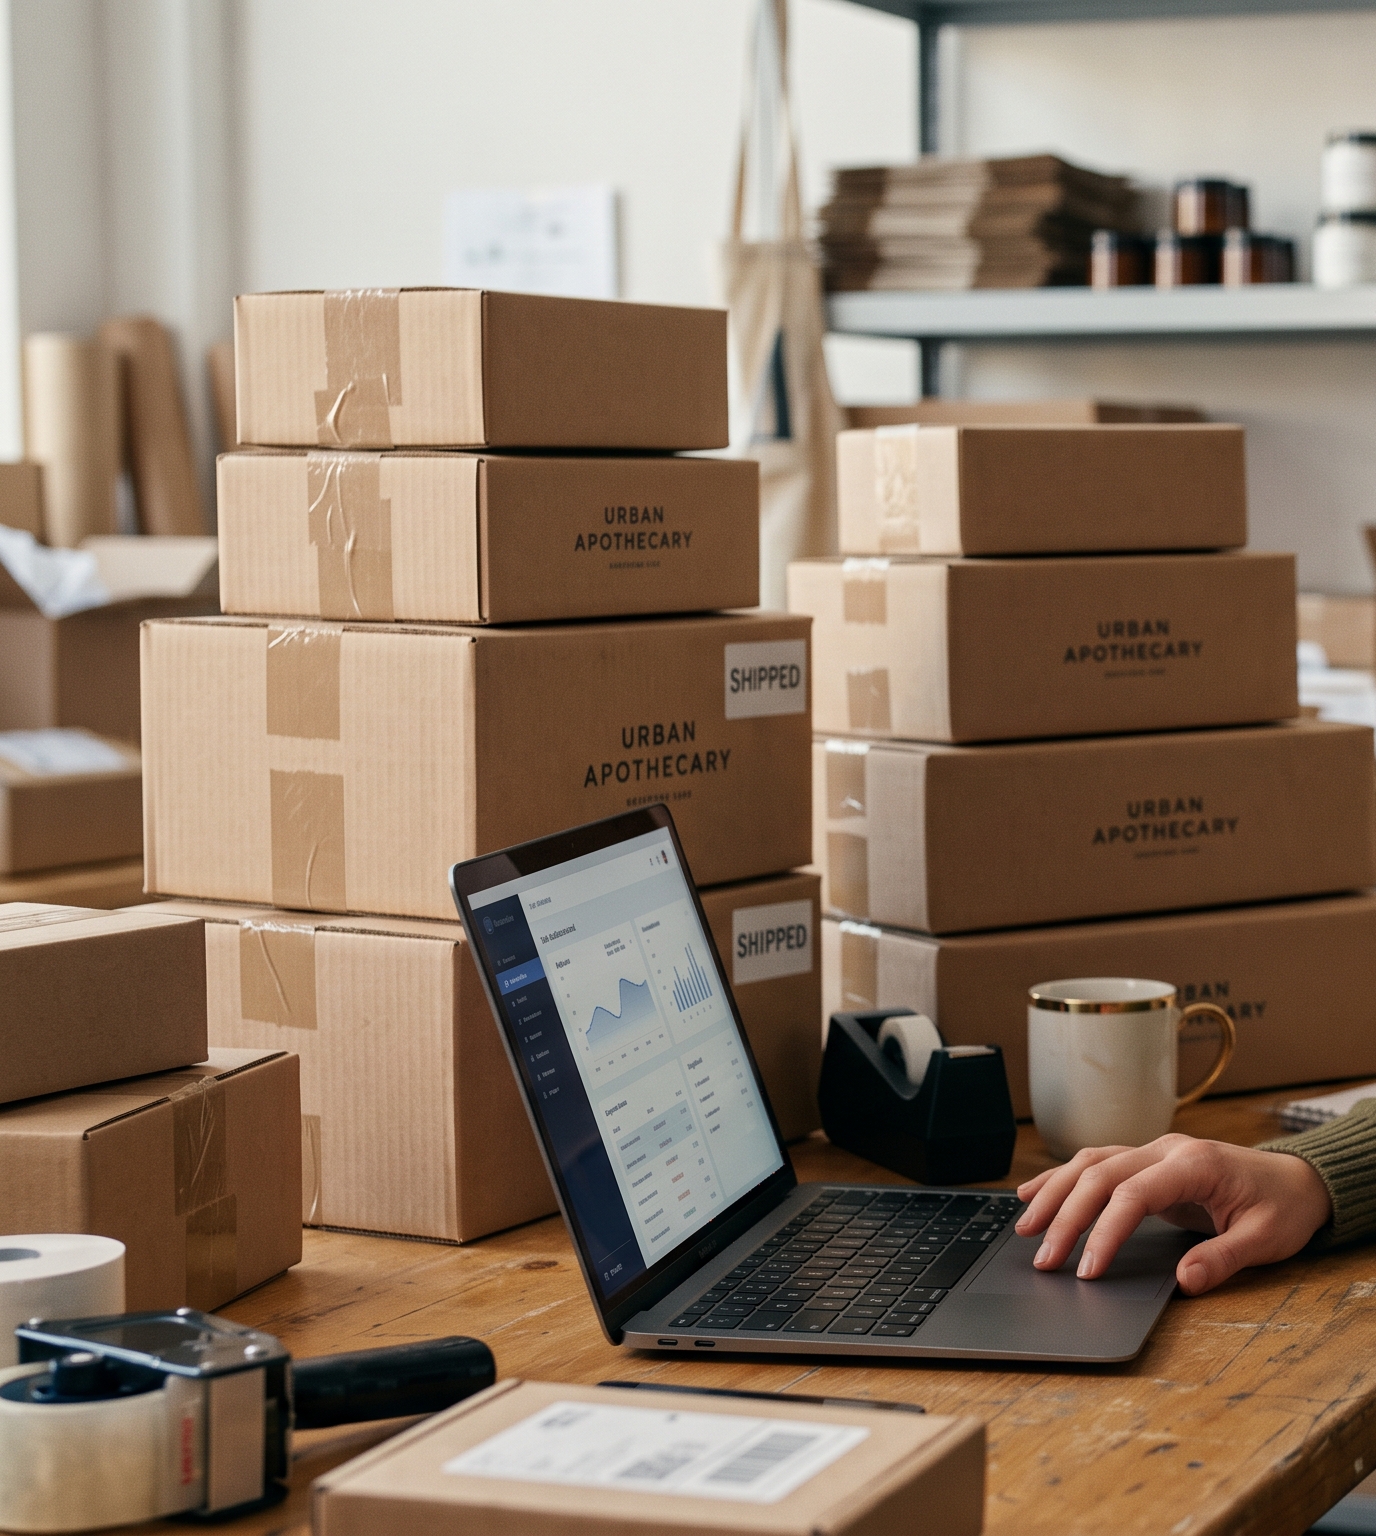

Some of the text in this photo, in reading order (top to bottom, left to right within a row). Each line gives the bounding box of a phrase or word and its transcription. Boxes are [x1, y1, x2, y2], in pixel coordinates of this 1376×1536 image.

[604, 505, 664, 524] URBAN
[574, 531, 693, 552] APOTHECARY
[1097, 619, 1170, 639] URBAN
[1063, 640, 1203, 664] APOTHECARY
[730, 664, 801, 693] SHIPPED
[621, 721, 696, 750] URBAN
[583, 749, 732, 788] APOTHECARY
[1127, 797, 1204, 819] URBAN
[1092, 817, 1239, 844] APOTHECARY
[737, 923, 807, 959] SHIPPED
